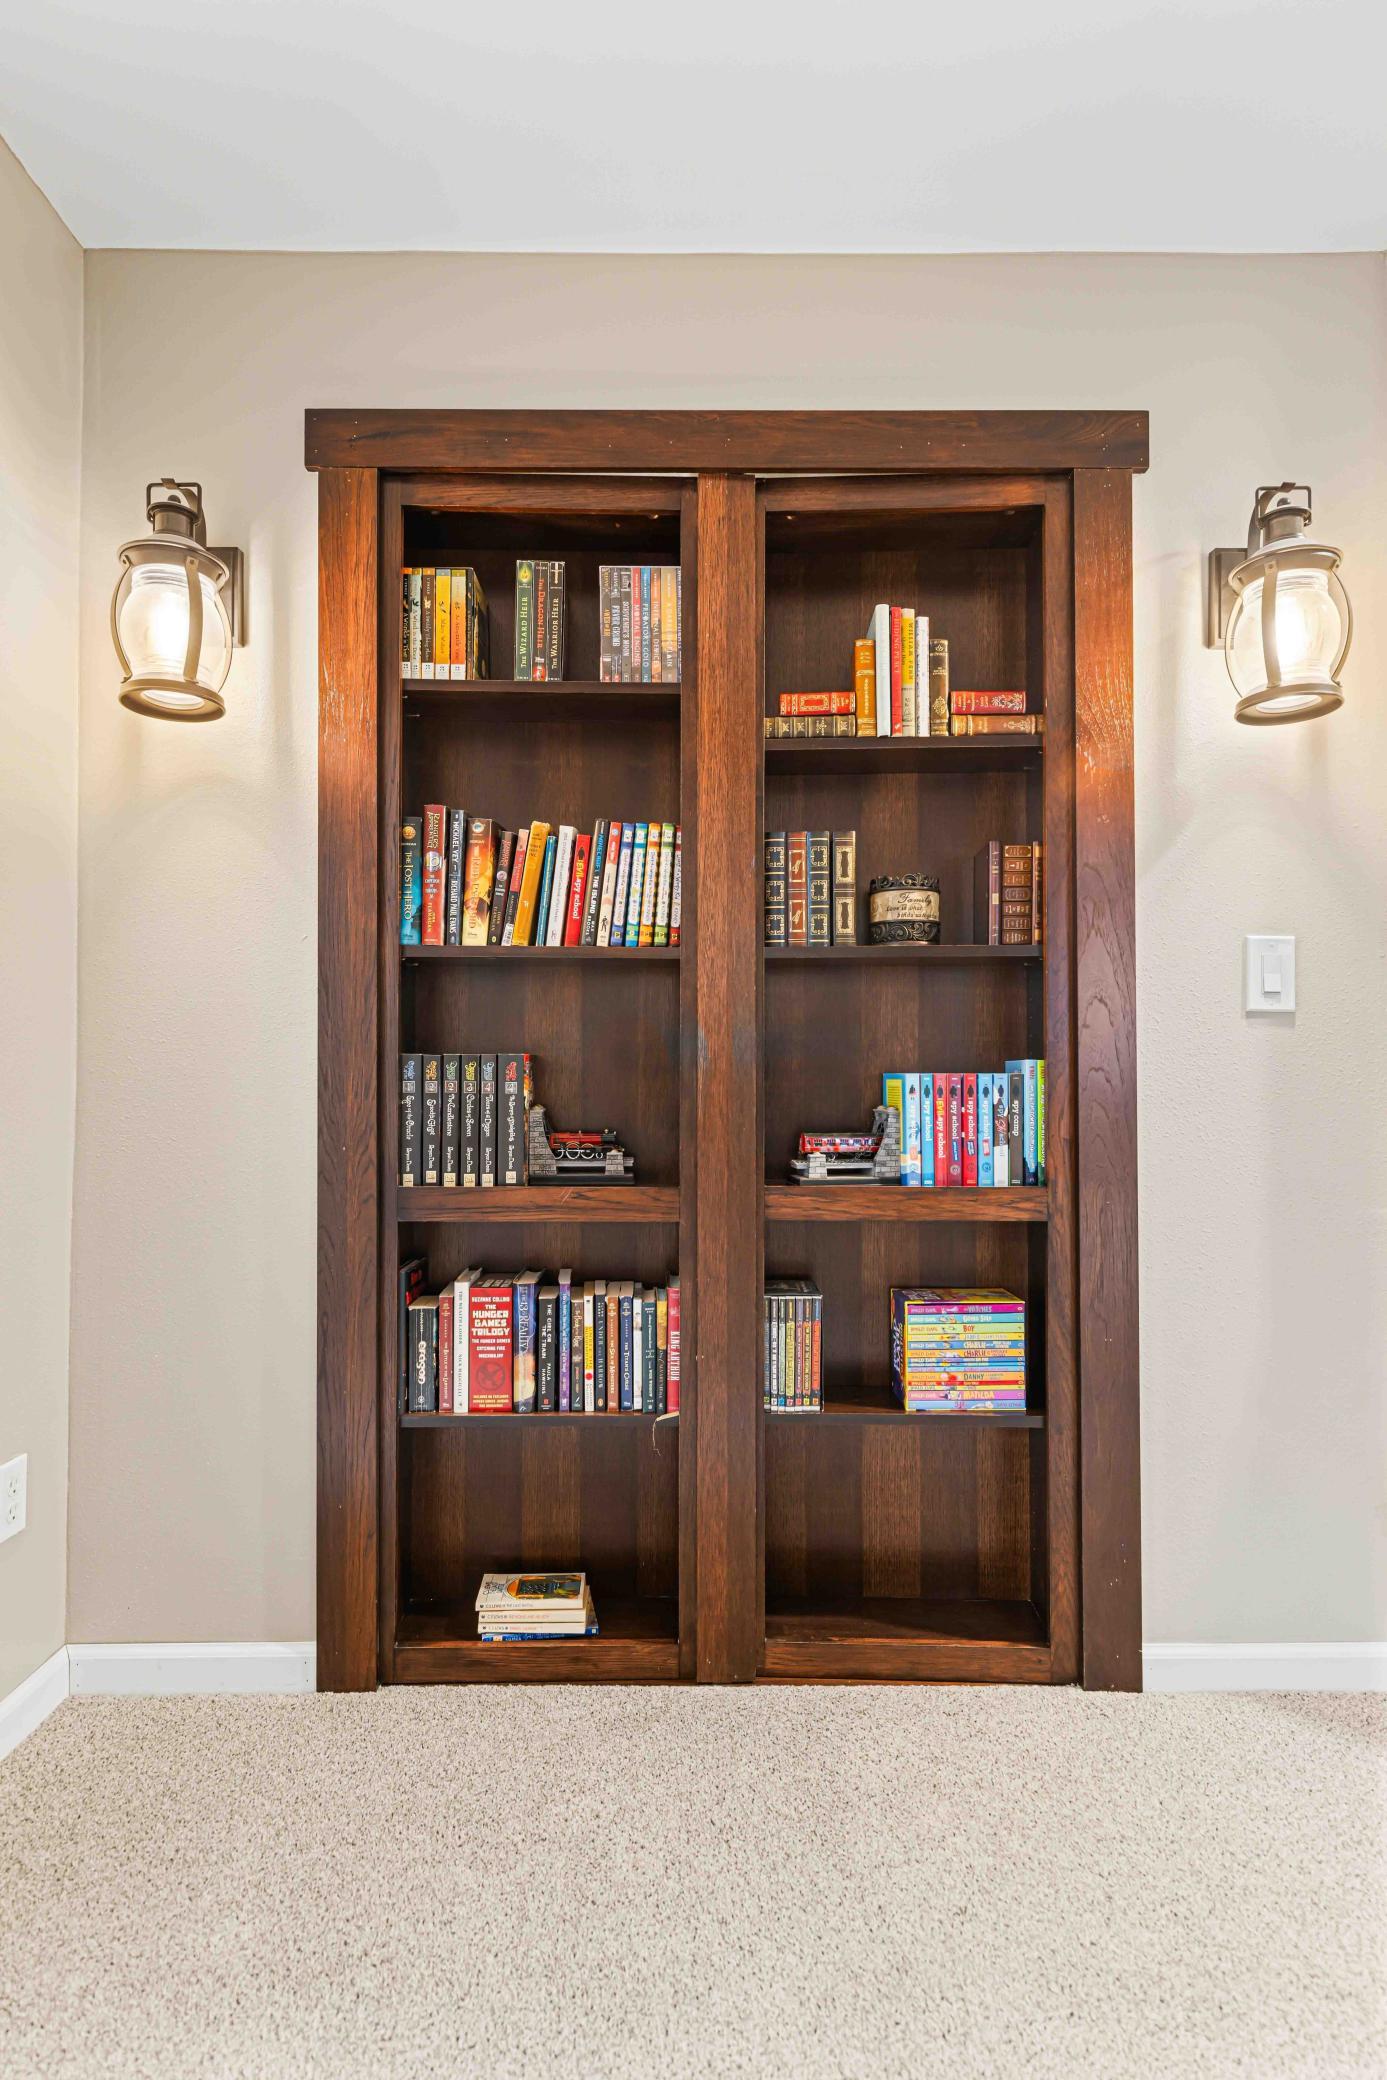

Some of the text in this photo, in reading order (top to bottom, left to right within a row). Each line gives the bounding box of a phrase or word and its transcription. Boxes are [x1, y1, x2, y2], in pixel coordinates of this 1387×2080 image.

[595, 834, 604, 873] MINECRAFT
[403, 864, 414, 888] LOST
[403, 891, 414, 920] HERO
[898, 892, 931, 906] Family
[446, 1103, 455, 1136] Candlestone
[416, 1341, 426, 1384] eragon
[671, 1331, 680, 1381] KING ARTHUR
